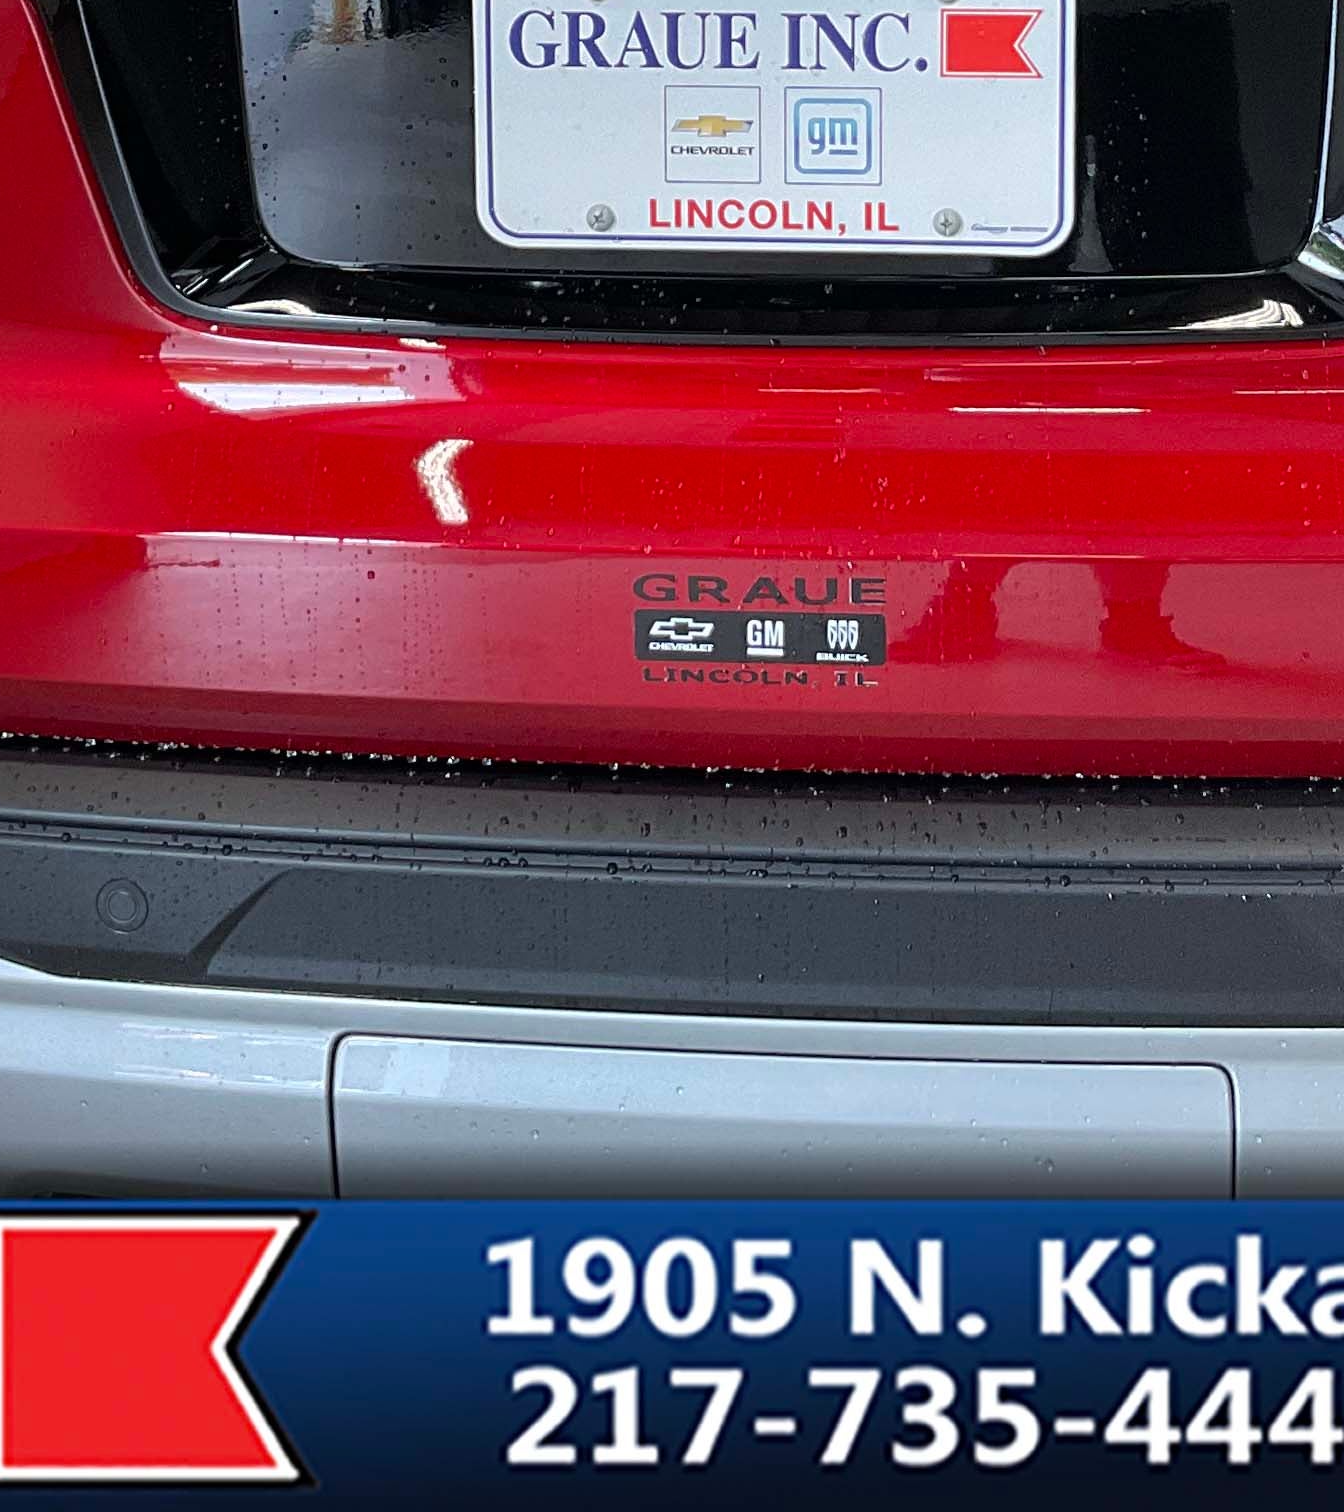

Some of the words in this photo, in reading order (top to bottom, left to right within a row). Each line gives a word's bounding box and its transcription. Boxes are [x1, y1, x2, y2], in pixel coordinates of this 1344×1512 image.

[508, 9, 759, 70] GRAUE
[780, 11, 929, 73] INC.
[807, 116, 858, 156] gm
[670, 144, 755, 157] CHEVROLET
[648, 198, 847, 235] LINCOLN,
[863, 200, 900, 232] IL
[632, 572, 888, 605] GRAUE
[648, 641, 714, 653] CHEVROLET
[746, 619, 785, 647] GM
[816, 652, 870, 663] BUICK
[834, 670, 878, 687] IL
